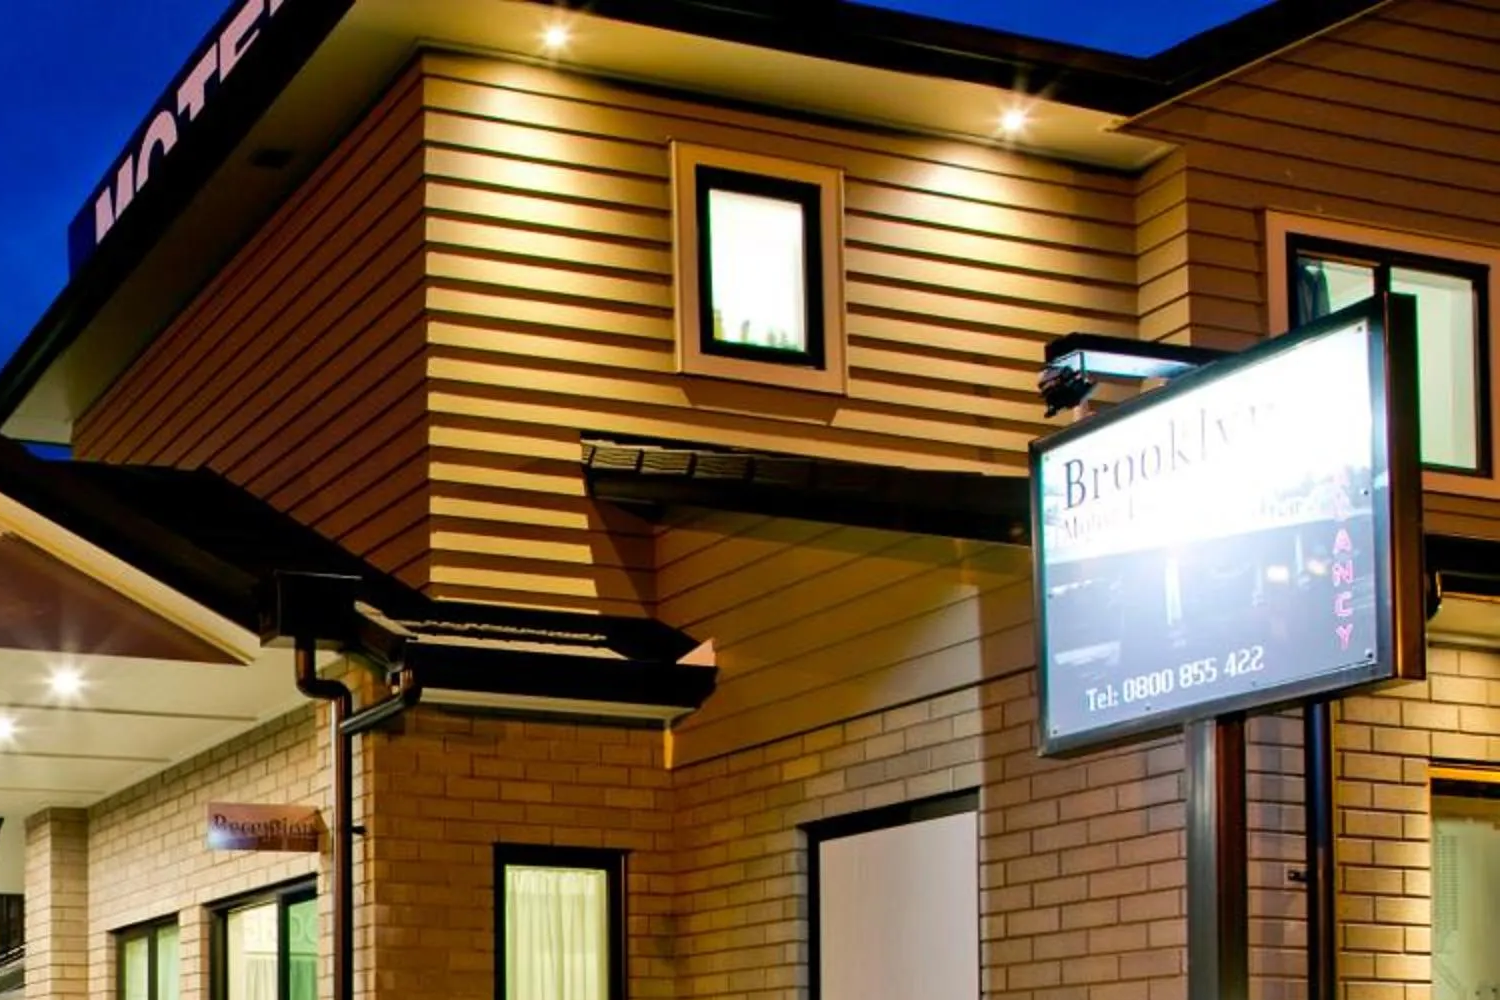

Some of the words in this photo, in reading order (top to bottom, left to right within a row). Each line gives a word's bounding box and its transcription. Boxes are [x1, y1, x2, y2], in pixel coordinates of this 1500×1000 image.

[95, 0, 285, 245] MOTE
[1062, 404, 1275, 511] Brookl
[1086, 684, 1119, 712] Tel:
[1123, 668, 1175, 704] 0800
[1179, 657, 1218, 689] 855
[1224, 645, 1264, 679] 422
